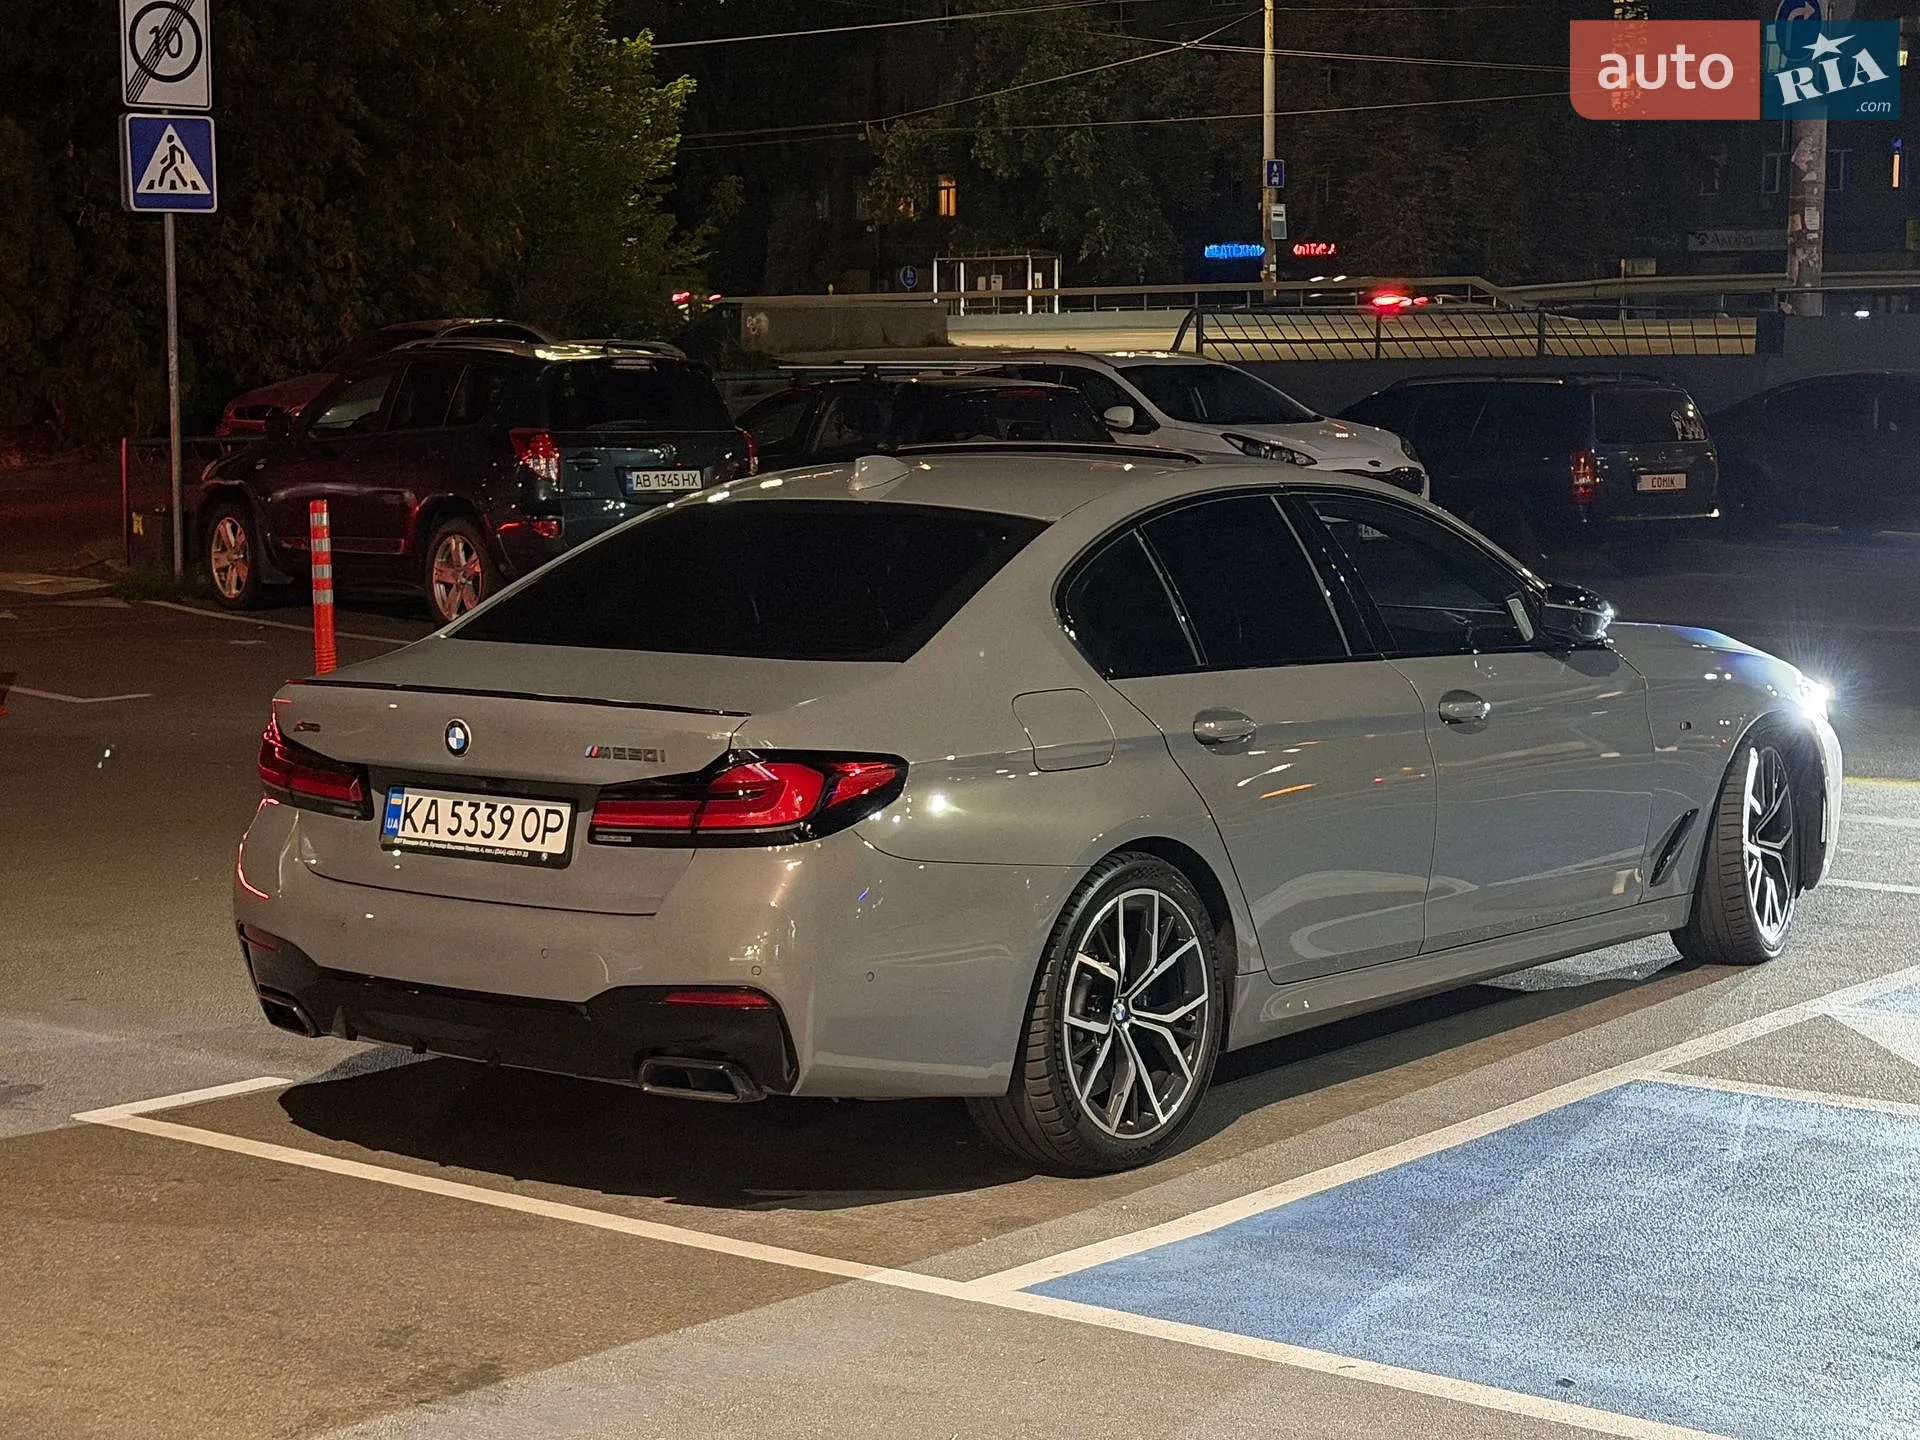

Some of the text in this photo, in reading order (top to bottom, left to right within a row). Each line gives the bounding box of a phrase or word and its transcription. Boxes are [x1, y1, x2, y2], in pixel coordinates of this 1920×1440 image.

[635, 473, 698, 489] AB 1345 HX
[386, 818, 399, 830] UA
[401, 796, 564, 845] KA 5339 OP
